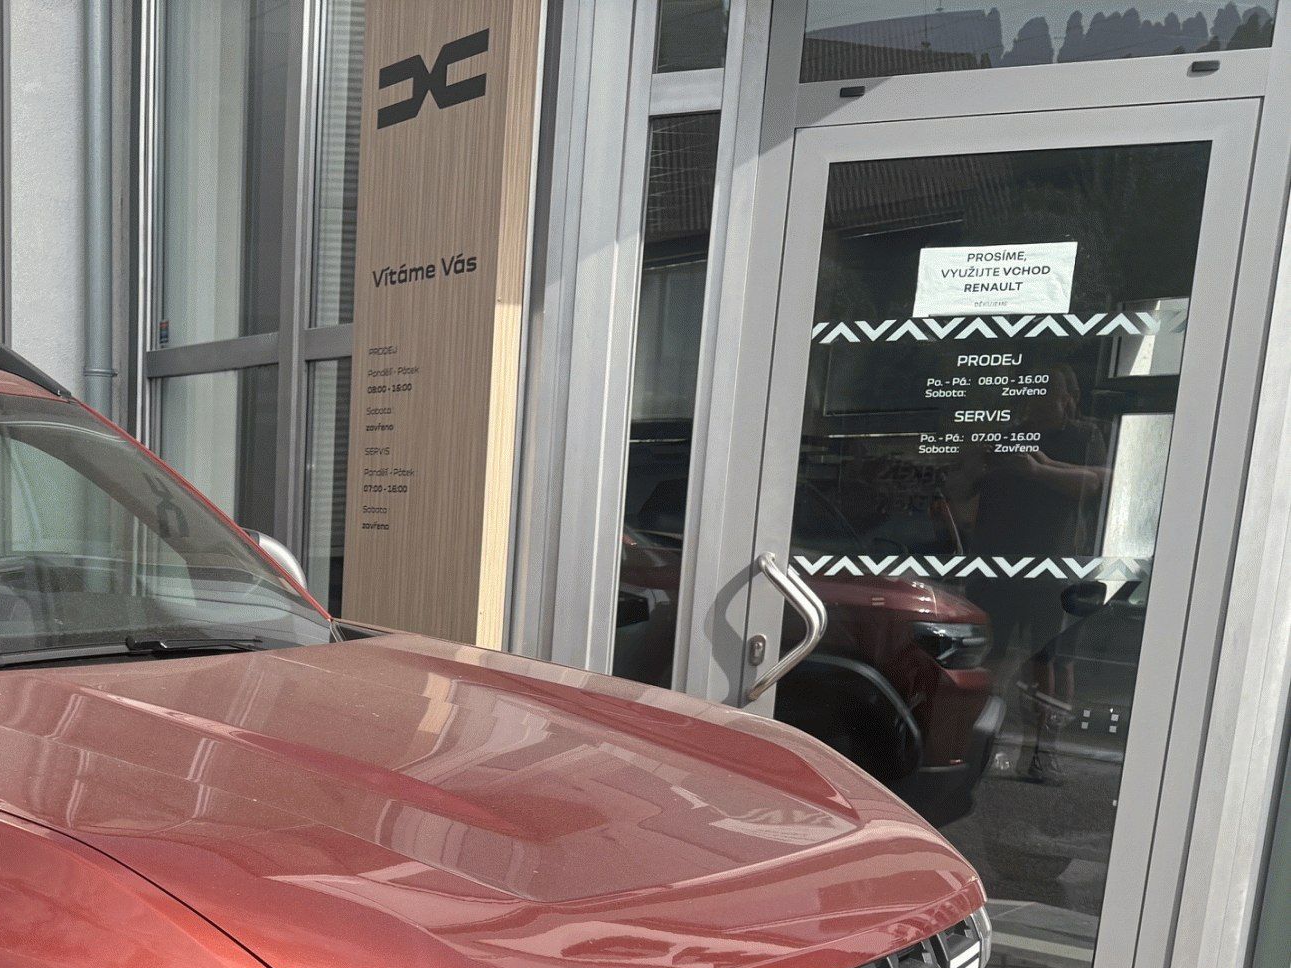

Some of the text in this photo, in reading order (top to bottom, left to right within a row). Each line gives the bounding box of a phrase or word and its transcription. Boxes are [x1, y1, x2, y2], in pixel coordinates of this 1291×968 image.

[967, 249, 1027, 262] PROSÍME,
[372, 253, 477, 288] Vítáme Vás
[941, 265, 1051, 278] VYUŽIJTE VCHOD
[963, 281, 1023, 293] RENAULT
[368, 346, 398, 355] PRODEJ
[957, 353, 1023, 367] PRODEJ
[927, 378, 944, 387] Po.
[978, 376, 1009, 386] 08.00
[1018, 374, 1050, 385] 16.00
[925, 386, 1047, 398] Sobota: Zavřeno
[954, 409, 1011, 422] SERVIS
[920, 434, 937, 443] Po.
[971, 432, 1002, 442] 07.00
[1010, 432, 1041, 442] 16.00
[365, 446, 390, 456] SERVIS
[918, 443, 1040, 454] Sobota: Zavřeno
